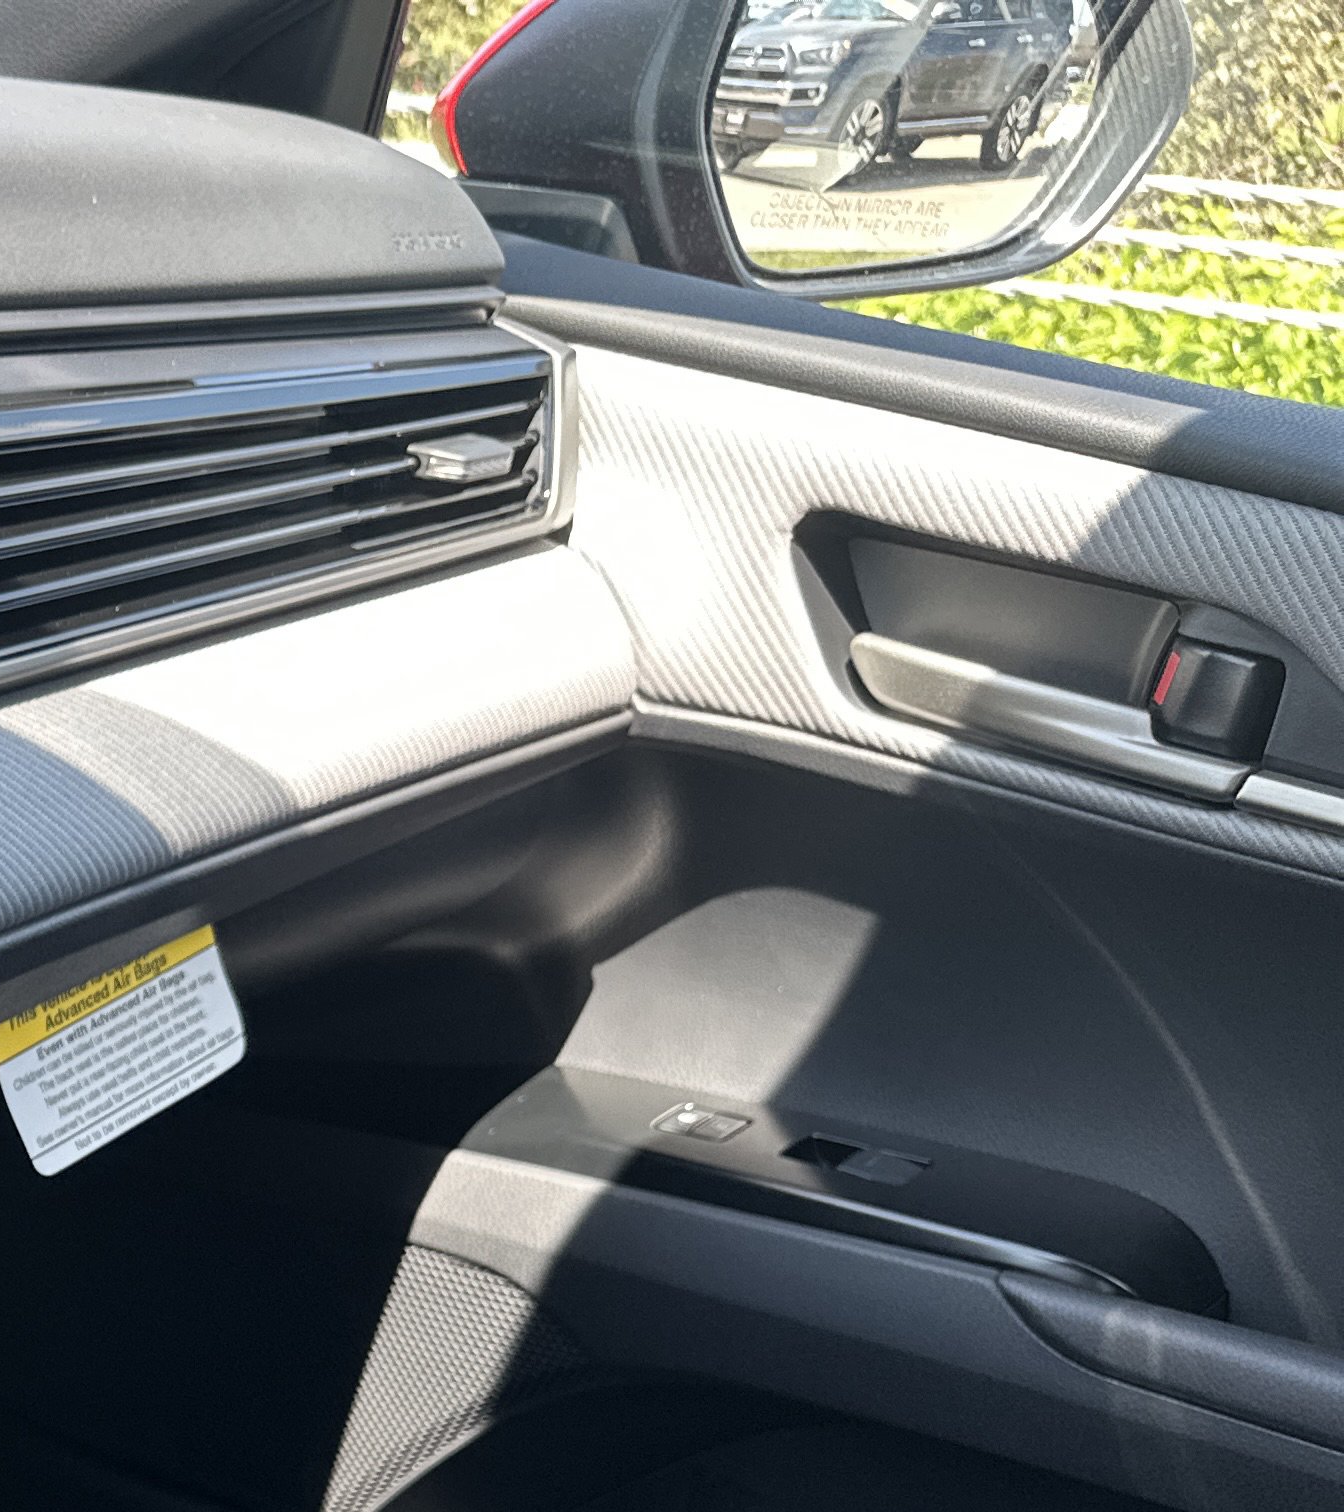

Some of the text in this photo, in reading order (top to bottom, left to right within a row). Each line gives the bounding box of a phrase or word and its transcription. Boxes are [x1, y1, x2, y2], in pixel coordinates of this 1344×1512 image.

[770, 192, 833, 212] OBJECTS
[854, 198, 912, 216] MIRROR
[915, 200, 944, 218] ARE
[45, 984, 110, 1031] Advanced
[113, 971, 131, 993] Air
[134, 954, 167, 981] Bags
